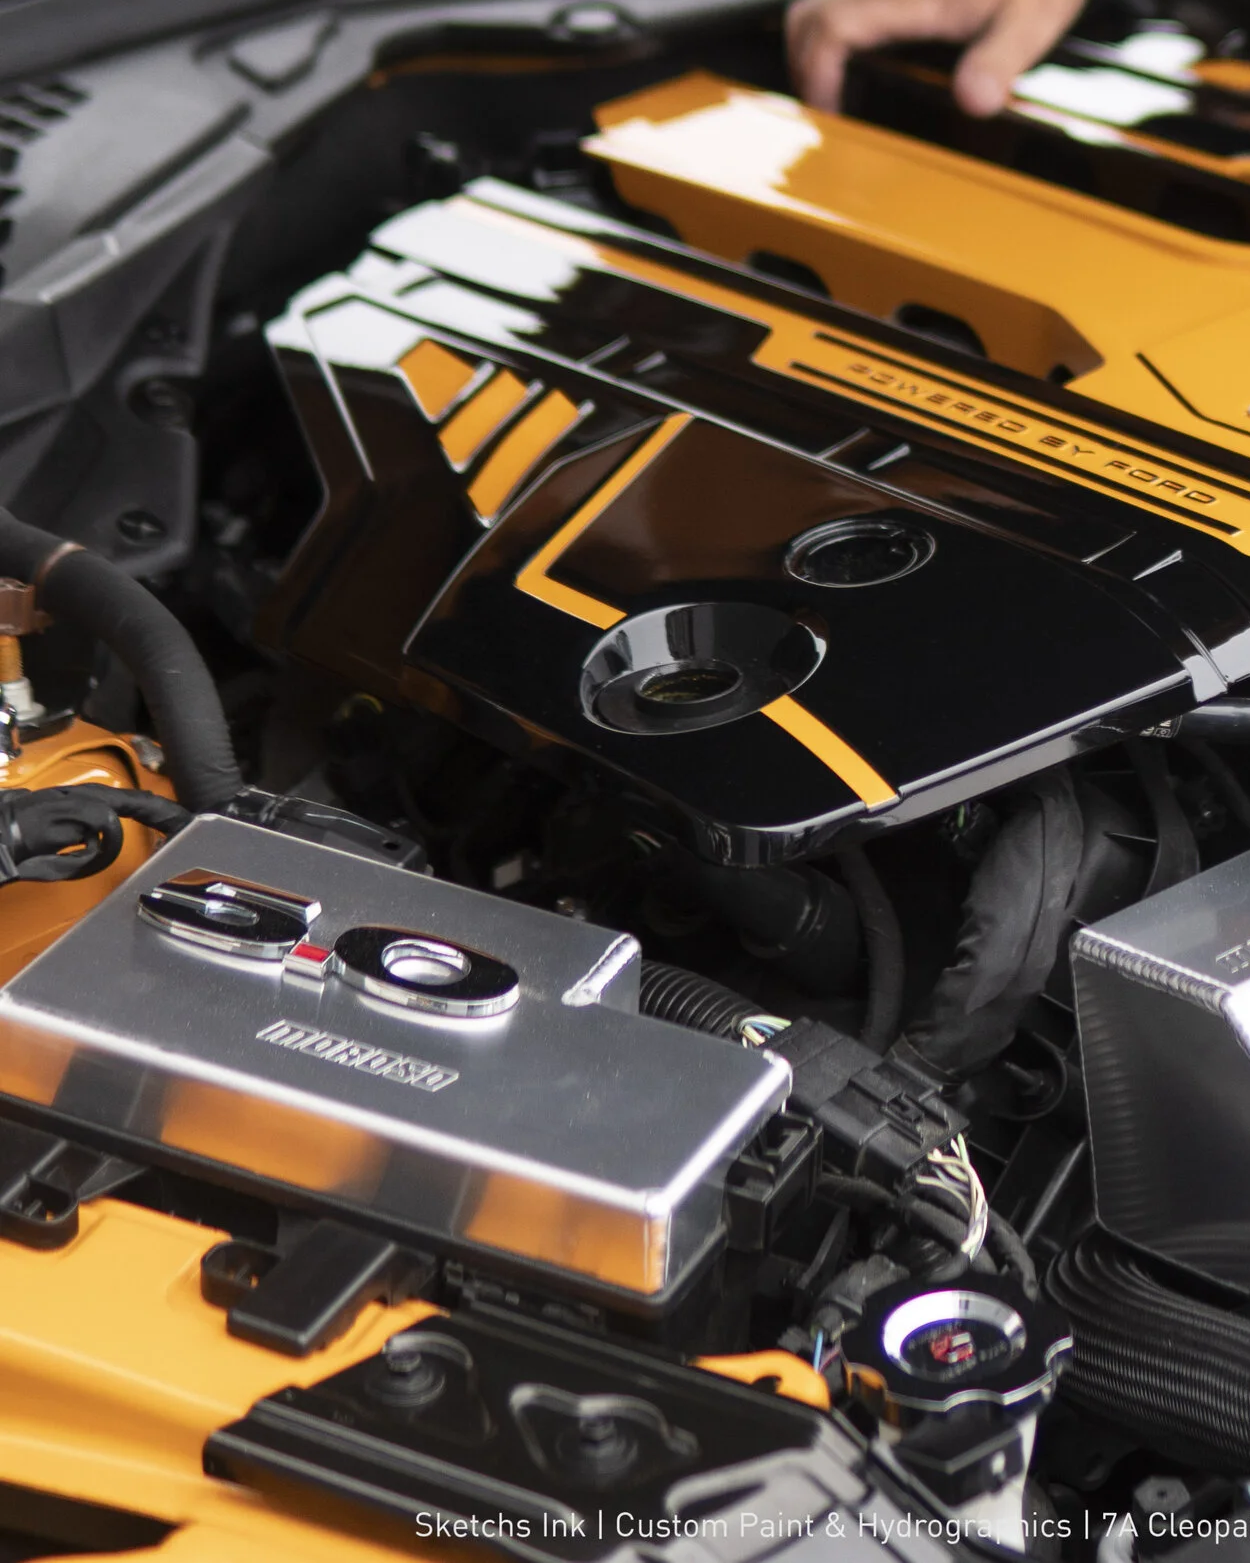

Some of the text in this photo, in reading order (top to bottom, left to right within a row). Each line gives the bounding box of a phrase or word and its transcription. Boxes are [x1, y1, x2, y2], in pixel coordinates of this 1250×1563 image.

[845, 363, 1220, 507] POWERED BY FORD
[137, 867, 520, 1018] 5.0
